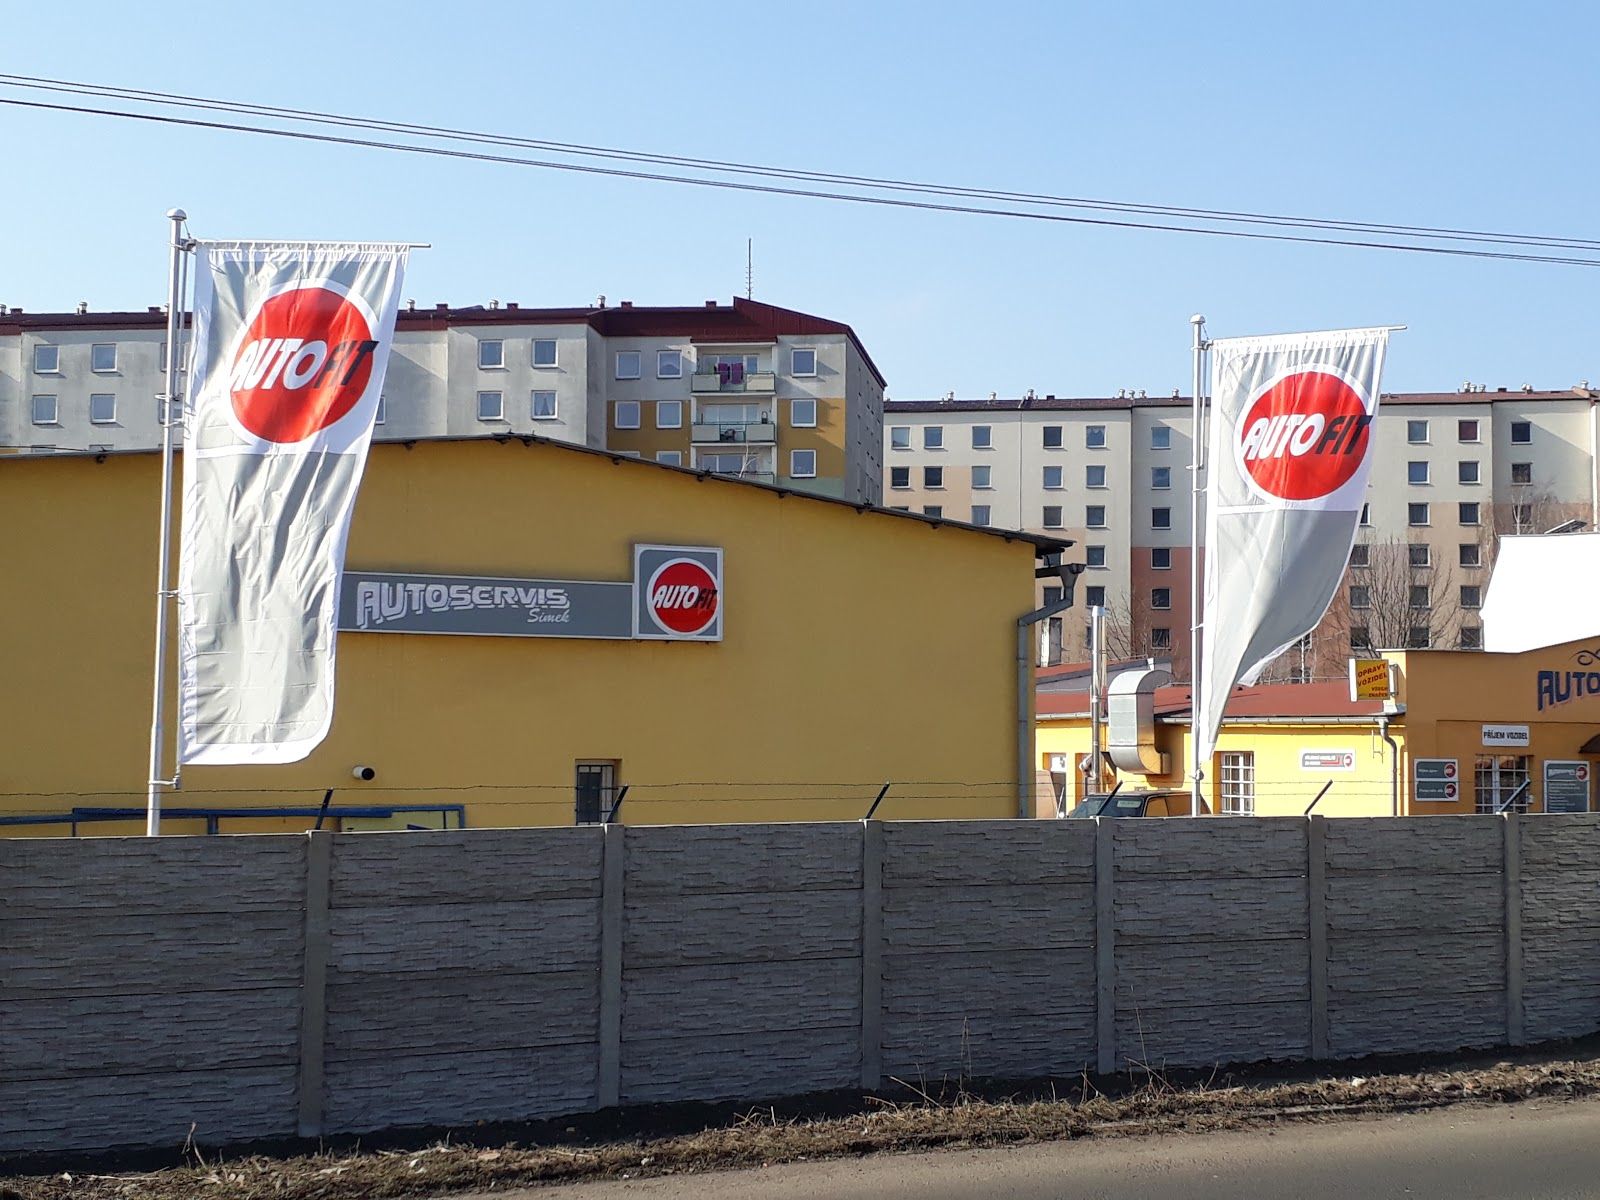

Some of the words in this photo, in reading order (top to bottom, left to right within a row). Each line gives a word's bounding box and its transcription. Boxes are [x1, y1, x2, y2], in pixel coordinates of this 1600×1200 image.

[230, 338, 379, 392] AUTOFIT
[1242, 413, 1373, 460] AUTOFIT
[356, 581, 570, 629] AUTOSERVIS
[653, 584, 718, 609] AUTOFIT
[1357, 662, 1387, 678] OPRAVY
[1357, 672, 1388, 687] VOZIDEL
[1506, 732, 1528, 740] VOZIDEL
